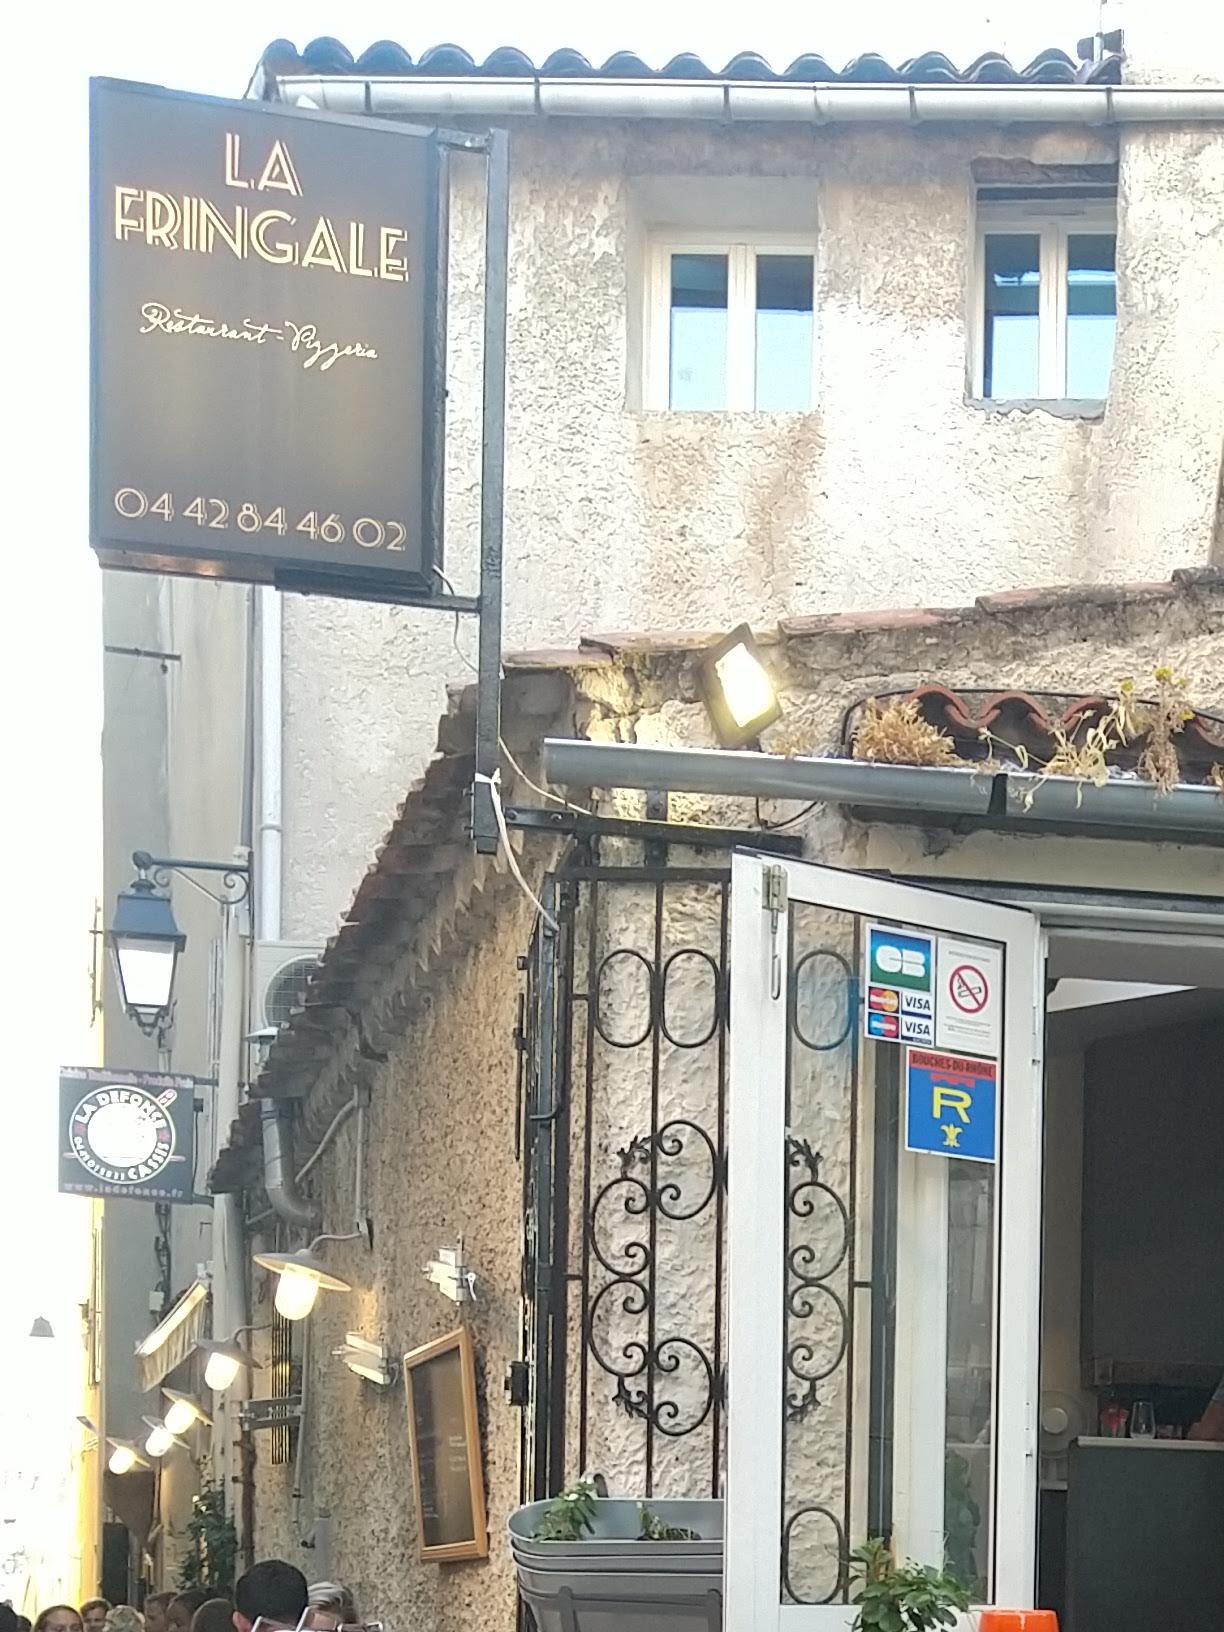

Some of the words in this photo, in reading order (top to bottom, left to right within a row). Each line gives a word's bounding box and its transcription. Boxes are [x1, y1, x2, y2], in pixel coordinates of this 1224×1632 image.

[224, 132, 304, 197] LA
[113, 185, 410, 282] FRINGALE
[114, 487, 175, 522] 04
[182, 496, 230, 528] 42
[236, 502, 288, 536] 84
[296, 511, 345, 544] 46
[352, 517, 407, 552] 02
[875, 944, 926, 978] CB
[905, 994, 931, 1011] VISA
[904, 1020, 931, 1037] VISA
[74, 1103, 98, 1124] LA
[932, 1085, 972, 1124] R
[127, 1142, 170, 1180] CASSIS
